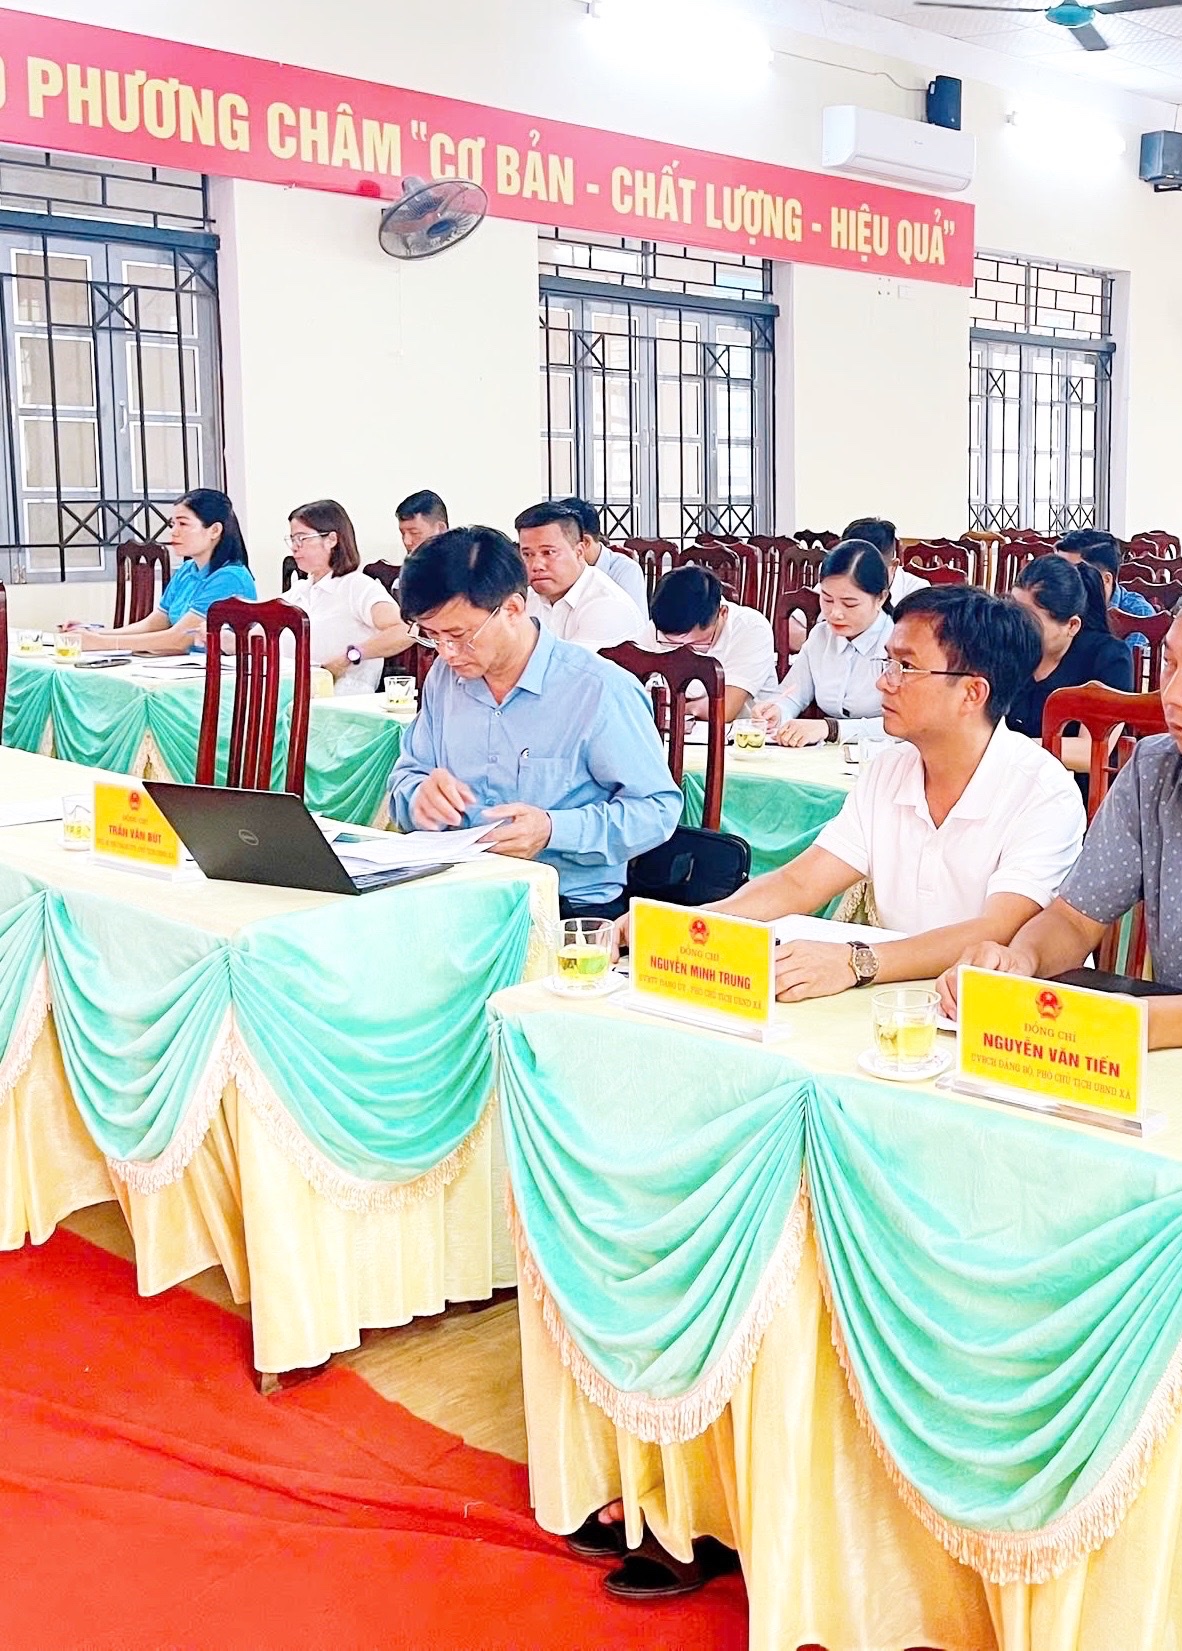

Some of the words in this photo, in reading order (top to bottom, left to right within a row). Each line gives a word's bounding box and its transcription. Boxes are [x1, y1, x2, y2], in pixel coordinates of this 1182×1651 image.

[27, 55, 250, 153] PHƯƠNG
[267, 102, 402, 177] CHÂM
[497, 129, 574, 205] BẢN
[611, 159, 696, 224] CHẤT
[706, 182, 803, 245] LƯỢNG
[831, 203, 889, 262] HIỆU
[897, 208, 955, 265] QUẢ"
[690, 965, 716, 982] MINH
[719, 971, 751, 990] TRUNG
[1024, 1021, 1054, 1038] ĐỒNG
[1057, 1029, 1076, 1043] CHÍ
[983, 1032, 1043, 1059] NGUYỄN
[1048, 1045, 1080, 1068] VĂN
[1085, 1055, 1120, 1078] TIẾN
